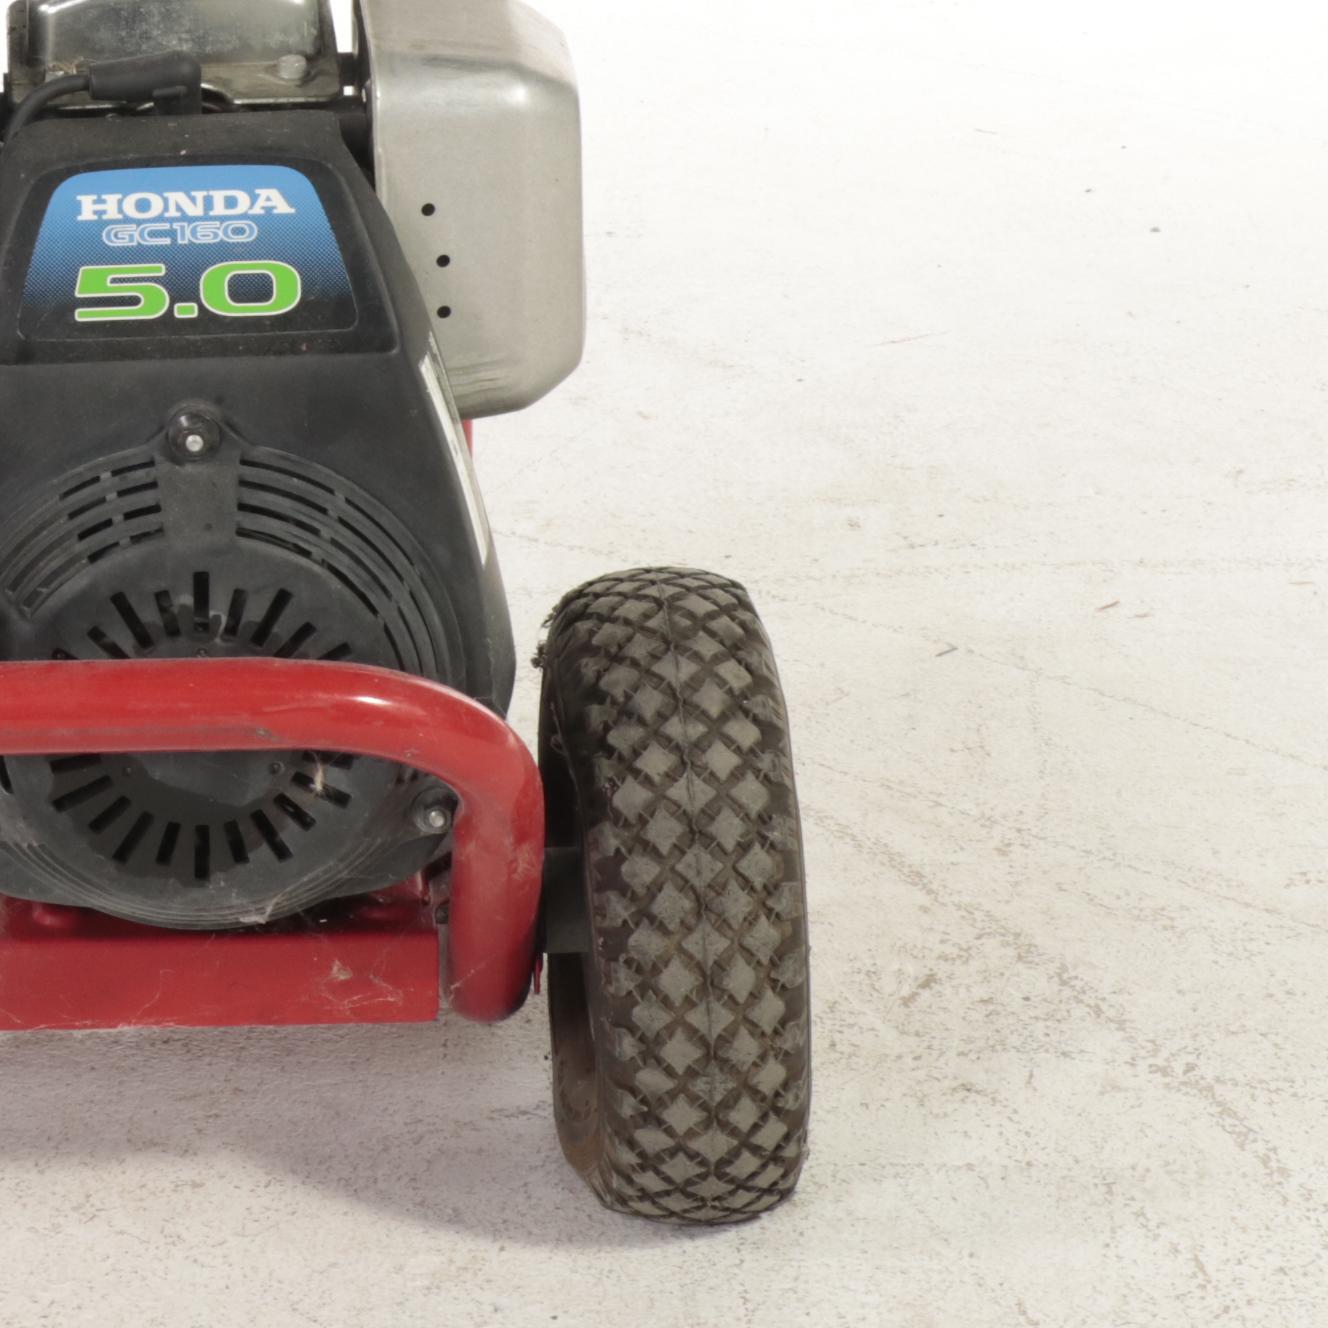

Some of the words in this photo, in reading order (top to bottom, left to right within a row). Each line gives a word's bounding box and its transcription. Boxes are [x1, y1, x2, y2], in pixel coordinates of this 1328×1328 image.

[76, 188, 296, 221] HONDA
[102, 220, 258, 246] GC160
[74, 260, 302, 322] 5.0
